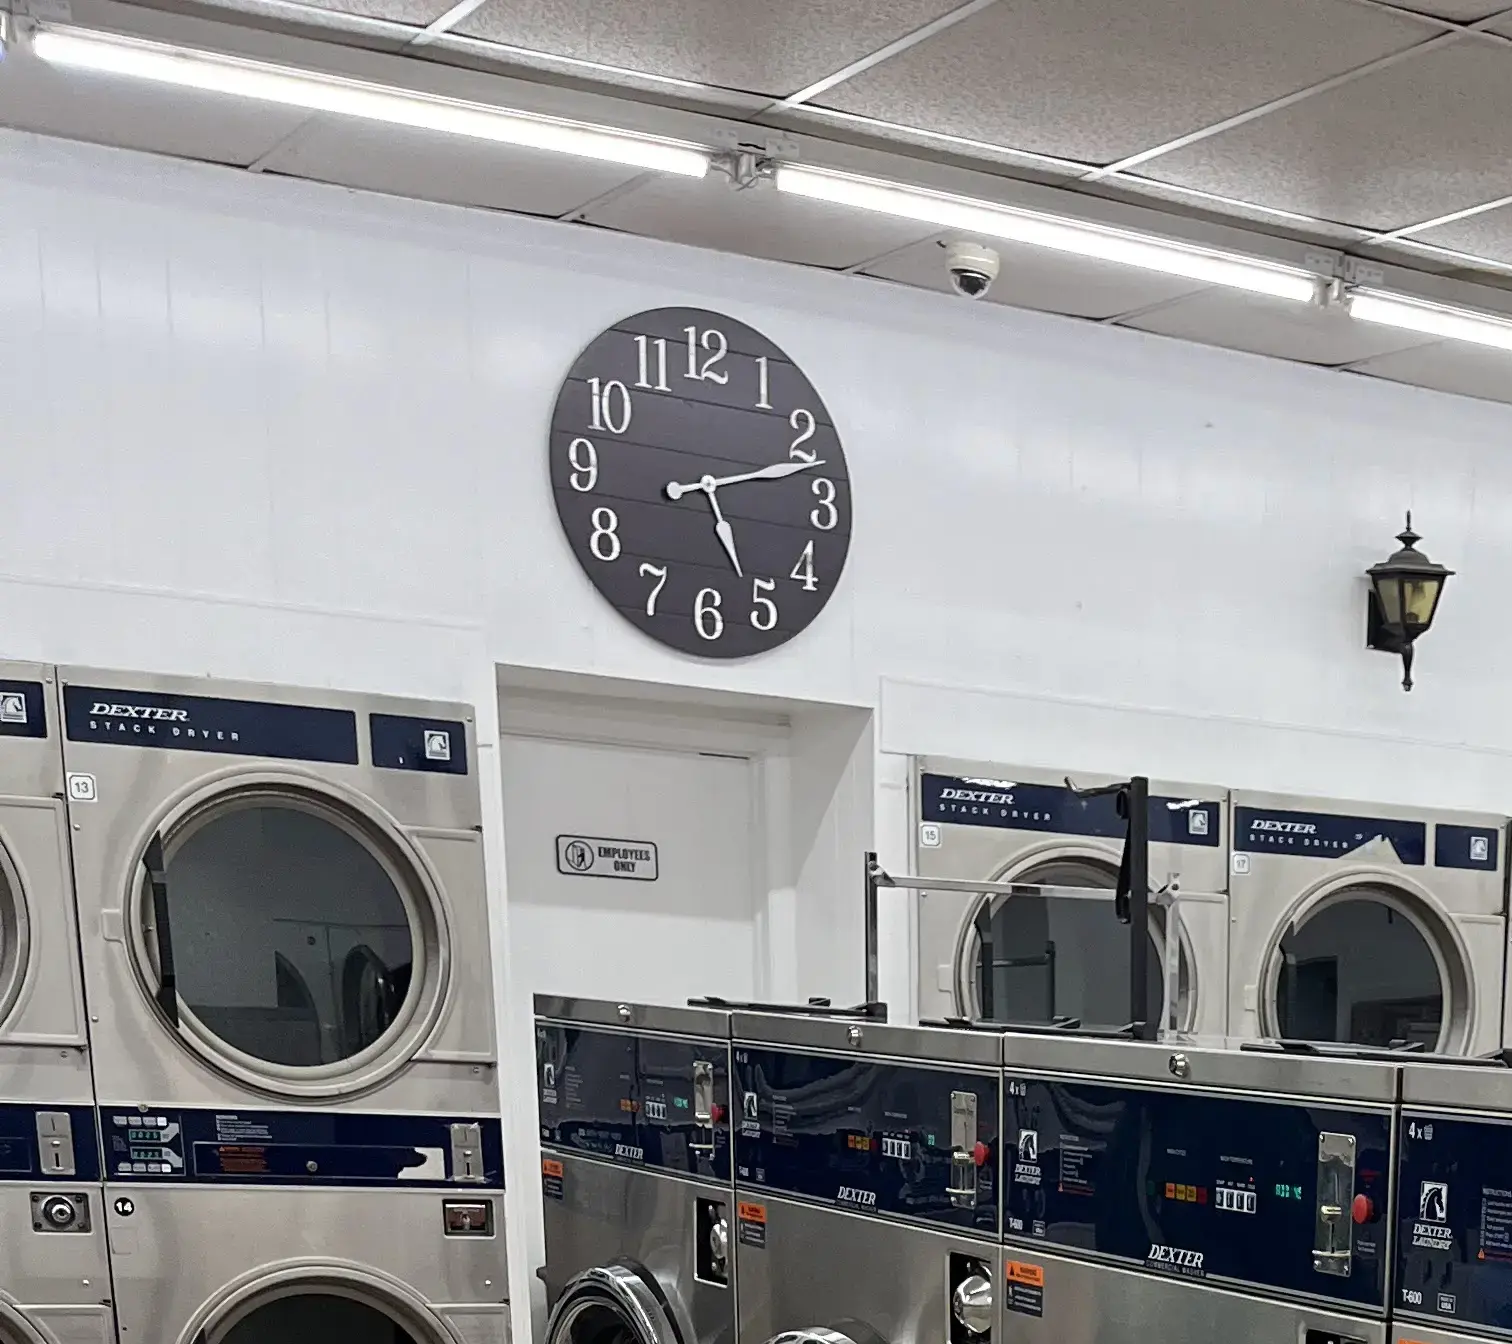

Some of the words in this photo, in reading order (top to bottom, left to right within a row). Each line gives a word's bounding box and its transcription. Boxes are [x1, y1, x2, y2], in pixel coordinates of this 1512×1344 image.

[634, 335, 672, 392] 11
[683, 326, 728, 385] 12
[755, 357, 773, 409] 1
[586, 377, 632, 434] 10
[789, 408, 816, 462] 2
[568, 438, 598, 492] 9
[810, 478, 838, 530] 3
[590, 507, 622, 561] 8
[790, 540, 818, 591] 4
[639, 563, 667, 616] 7
[694, 587, 724, 640] 6
[750, 577, 778, 630] 5
[89, 702, 189, 722] DEXTER
[89, 720, 156, 734] STACK
[172, 726, 240, 742] DRYER
[74, 781, 89, 794] 13
[939, 788, 1015, 805] DEXTER
[939, 803, 989, 815] STACK
[1000, 809, 1051, 821] DRYER
[925, 831, 937, 841] 15
[1250, 819, 1317, 834] DEXTER
[598, 846, 651, 861] EMPLOYEES
[613, 860, 636, 872] ONLY
[1408, 1121, 1416, 1139] 4
[614, 1143, 644, 1160] DEXTER
[837, 1185, 877, 1206] DEXTER
[116, 1201, 133, 1212] 14
[1412, 1223, 1452, 1239] DEXTER
[1147, 1243, 1204, 1268] DEXTER
[1402, 1288, 1423, 1305] T-600
